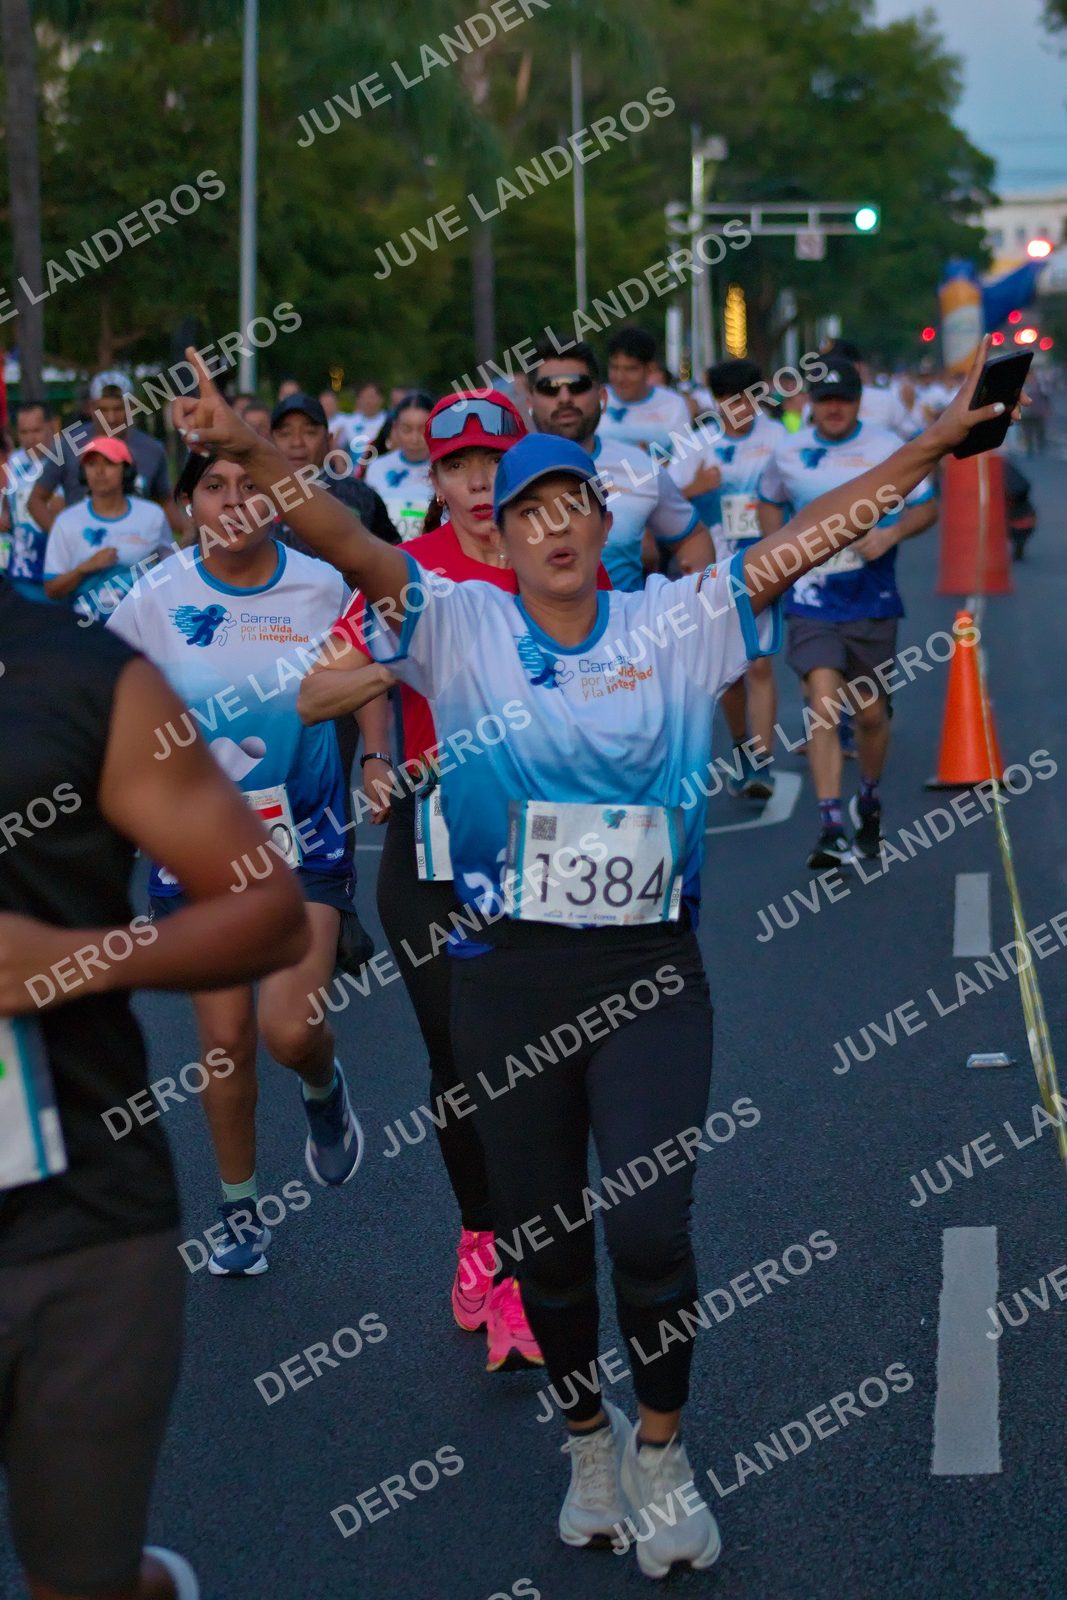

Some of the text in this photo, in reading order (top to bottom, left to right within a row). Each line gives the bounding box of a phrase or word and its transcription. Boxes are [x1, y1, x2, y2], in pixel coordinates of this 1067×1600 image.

[240, 613, 291, 624] Carrera
[240, 624, 292, 634] por la Vida
[259, 633, 309, 643] Integridad
[536, 853, 665, 908] 1384
